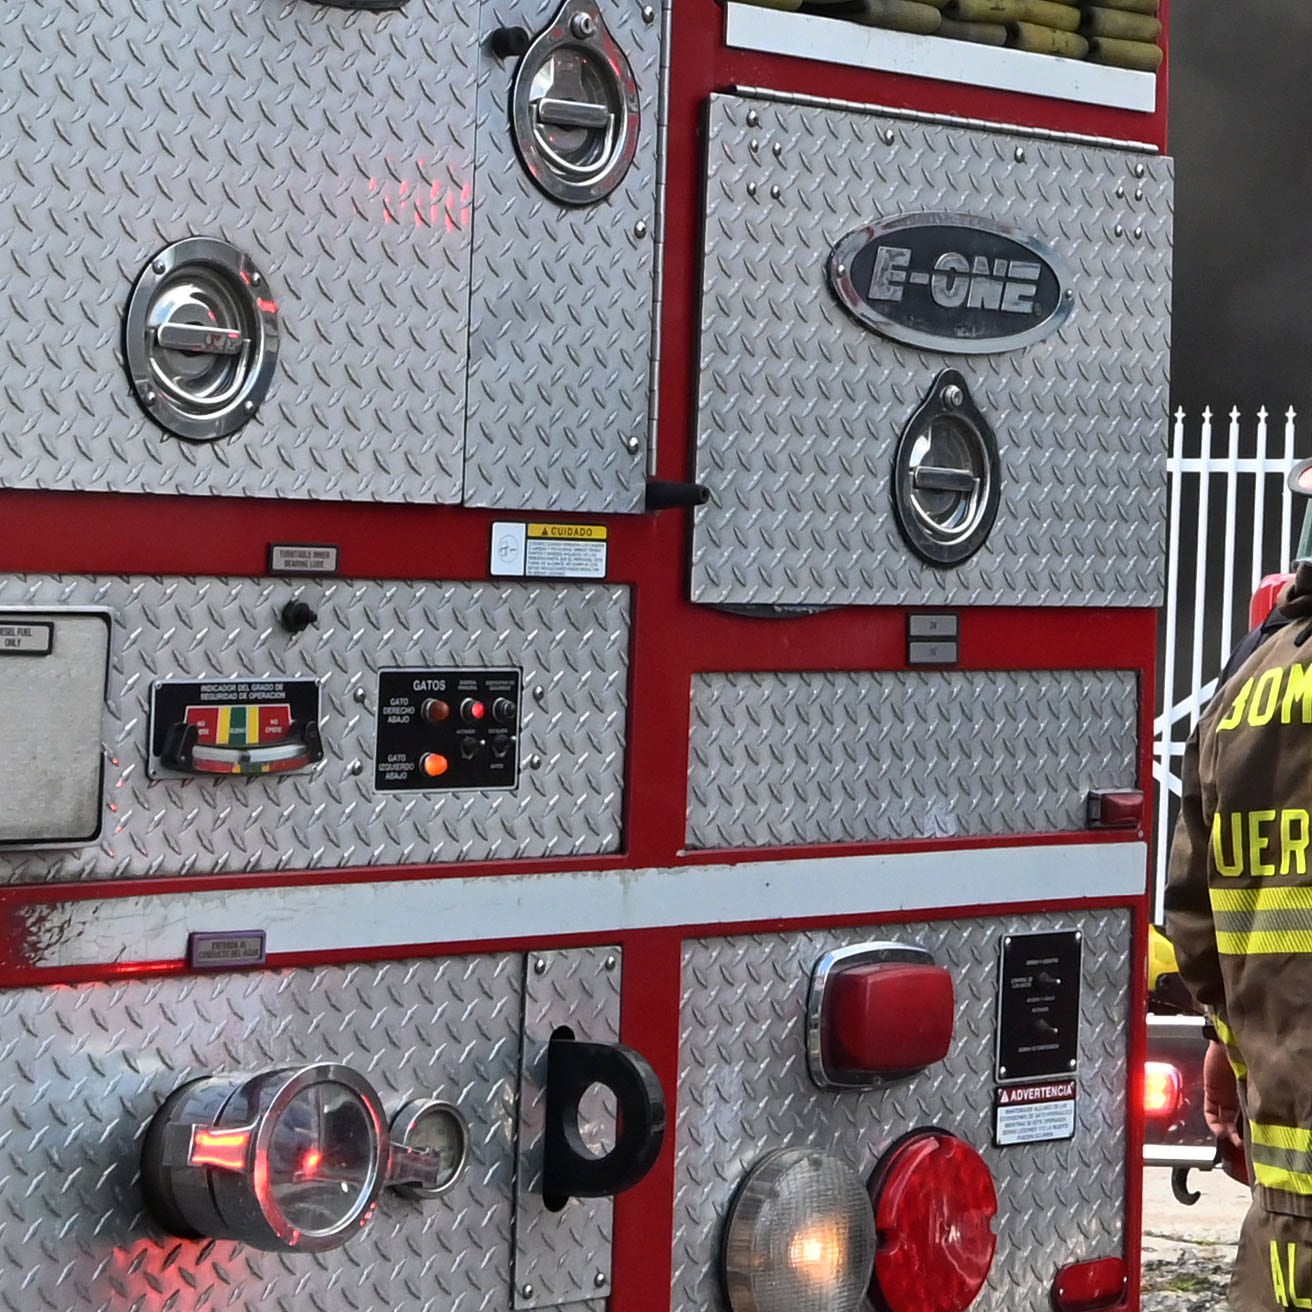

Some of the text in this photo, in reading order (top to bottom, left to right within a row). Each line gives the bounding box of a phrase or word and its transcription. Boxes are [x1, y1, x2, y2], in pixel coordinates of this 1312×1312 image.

[867, 245, 1041, 314] E-ONE
[550, 525, 593, 537] CUIDADO
[17, 627, 32, 637] FUEL
[4, 638, 22, 647] ONLY
[237, 684, 250, 692] DEL
[274, 683, 284, 691] DE
[413, 680, 446, 691] GATOS
[238, 692, 248, 700] DE
[390, 698, 408, 706] GATO
[382, 706, 415, 715] DERECHO
[387, 715, 410, 724] ABAJO
[387, 754, 407, 762] GATO
[385, 772, 408, 780] ABAJO
[1010, 1085, 1072, 1102] ADVERTENCIA
